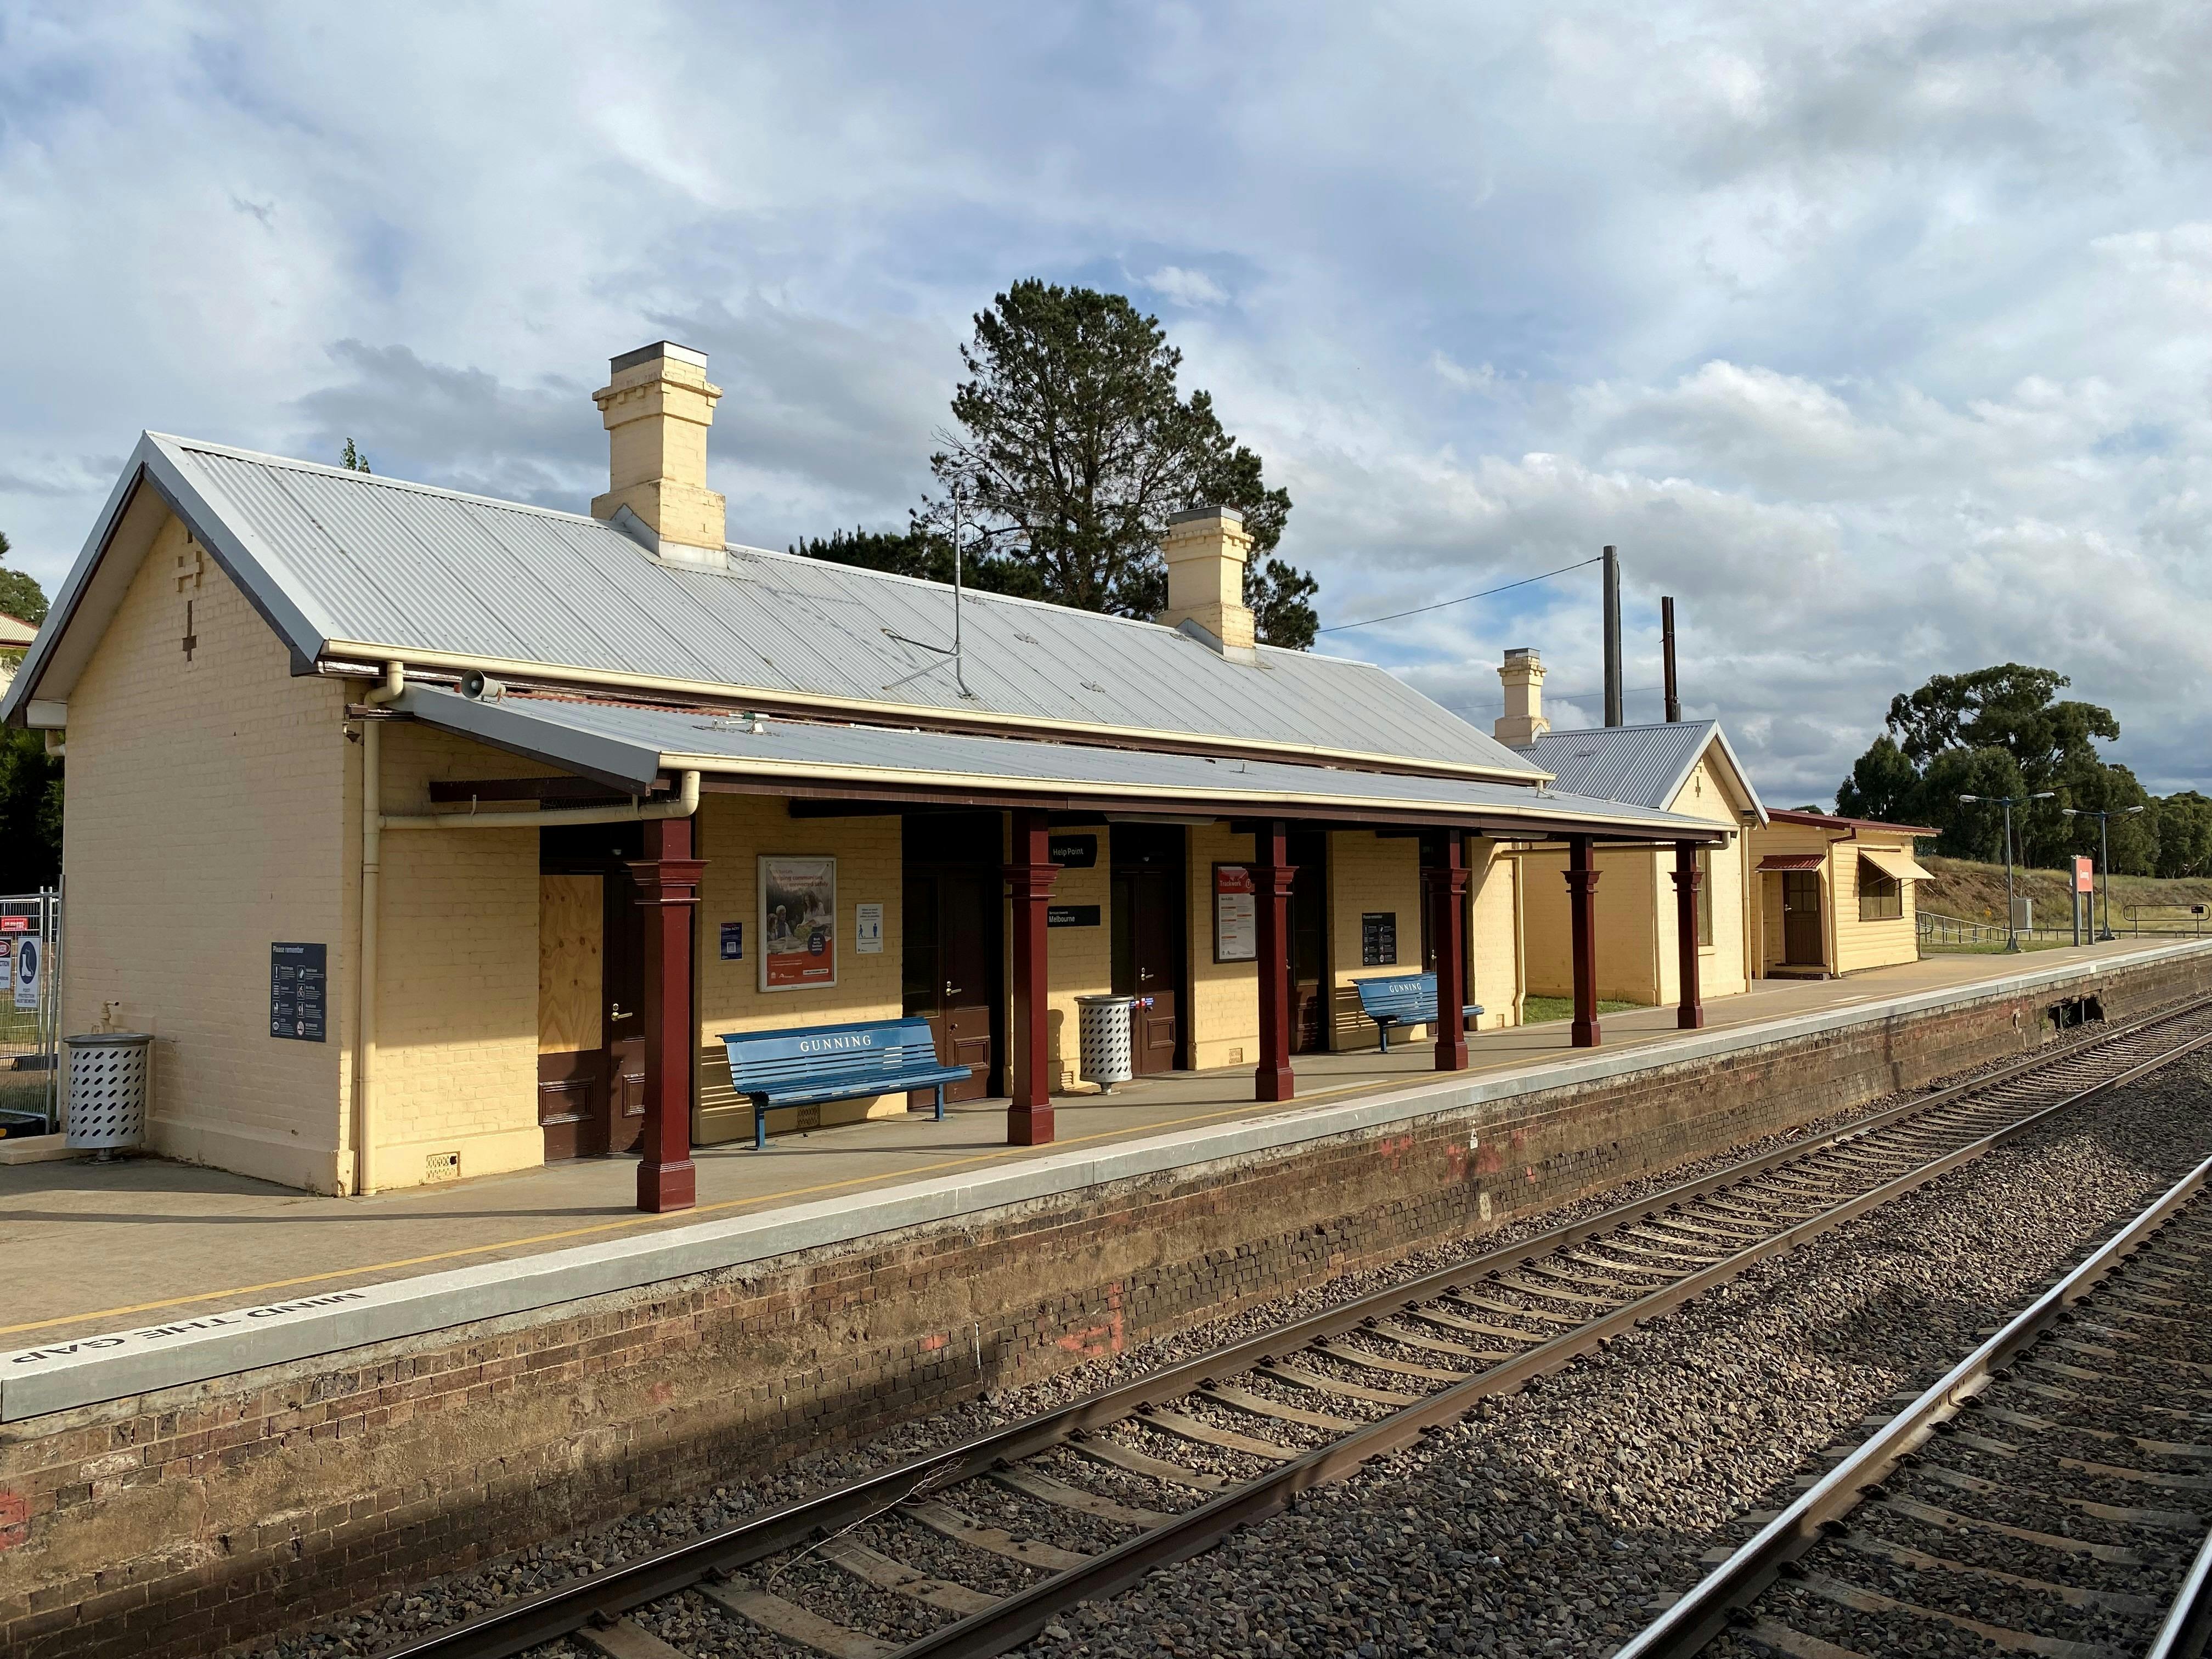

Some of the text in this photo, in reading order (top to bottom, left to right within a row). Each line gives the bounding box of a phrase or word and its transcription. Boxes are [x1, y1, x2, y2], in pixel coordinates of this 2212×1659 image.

[1053, 848, 1067, 857] Help
[1389, 983, 1422, 993] GUNNING
[800, 1035, 872, 1052] GUNNING
[12, 1293, 366, 1364] MIND THE GAP
